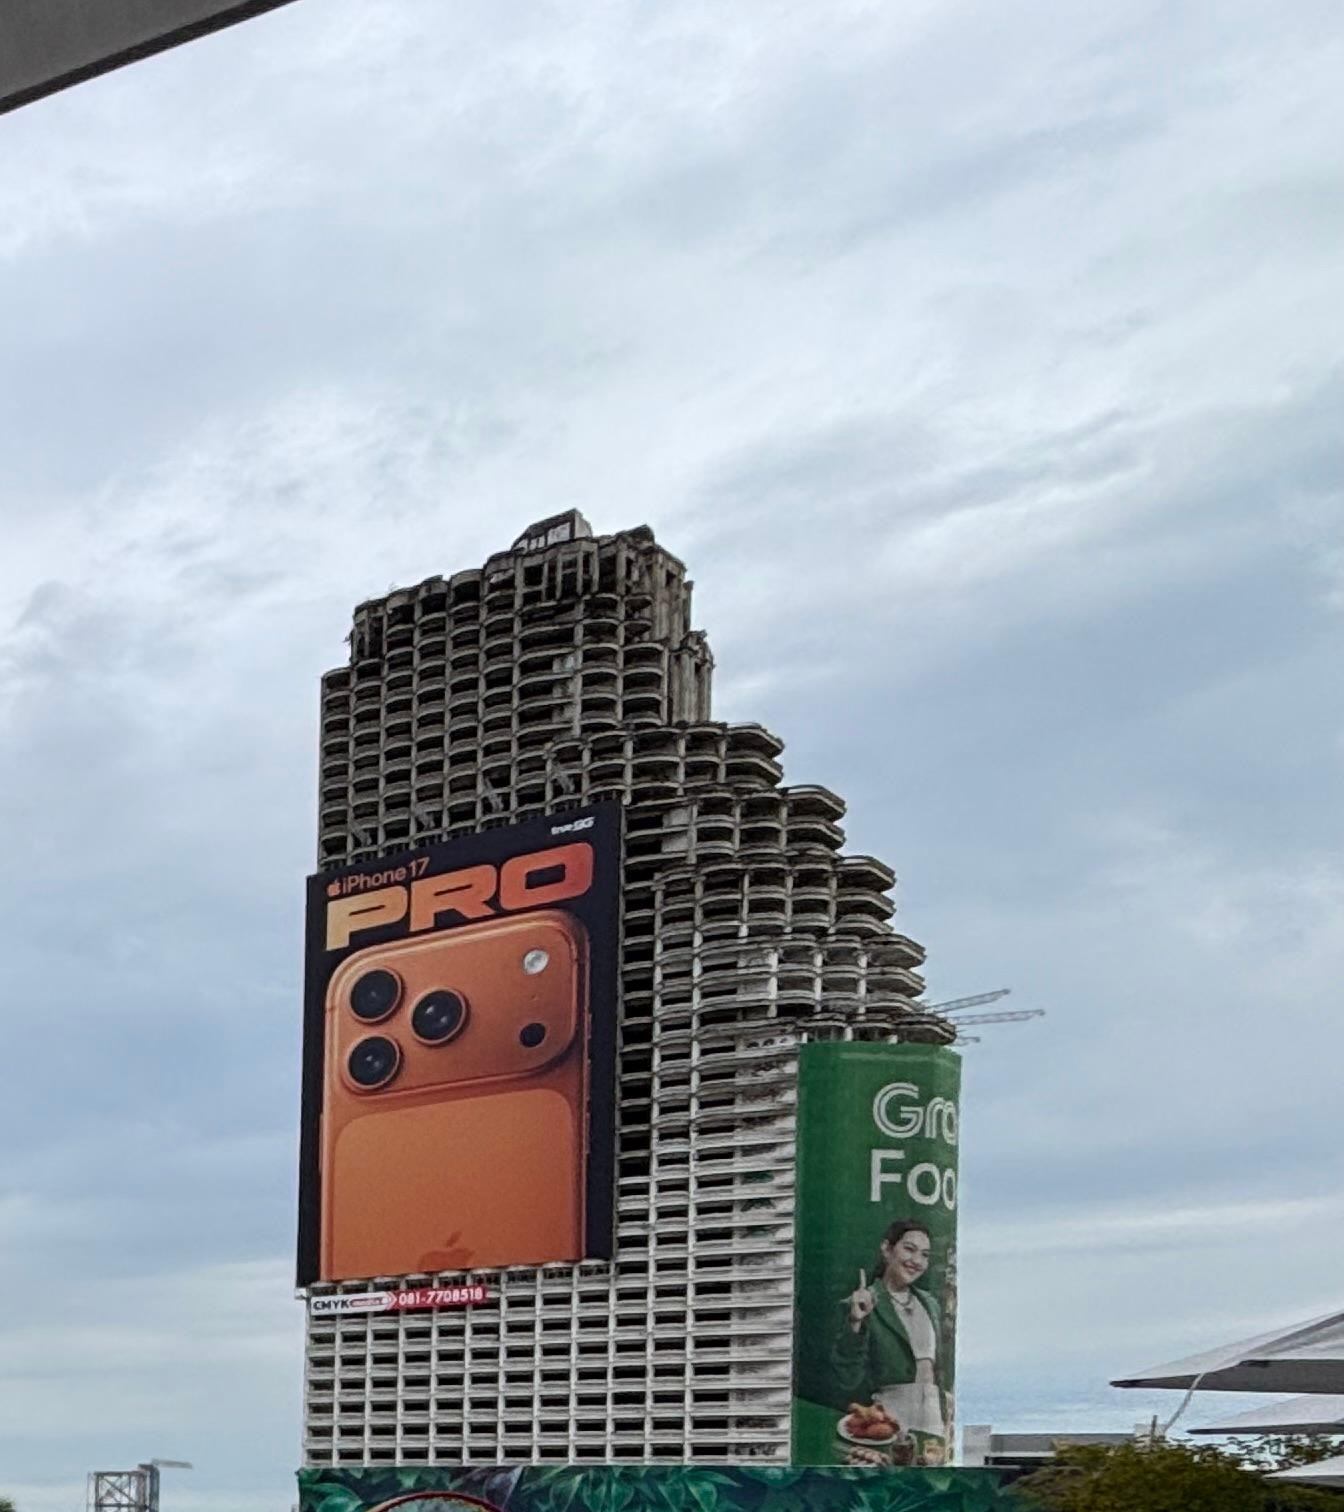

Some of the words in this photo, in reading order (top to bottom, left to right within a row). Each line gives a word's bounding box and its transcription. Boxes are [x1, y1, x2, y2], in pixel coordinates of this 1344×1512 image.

[326, 842, 594, 951] PRO
[343, 867, 406, 895] iPhone
[411, 856, 430, 878] 17
